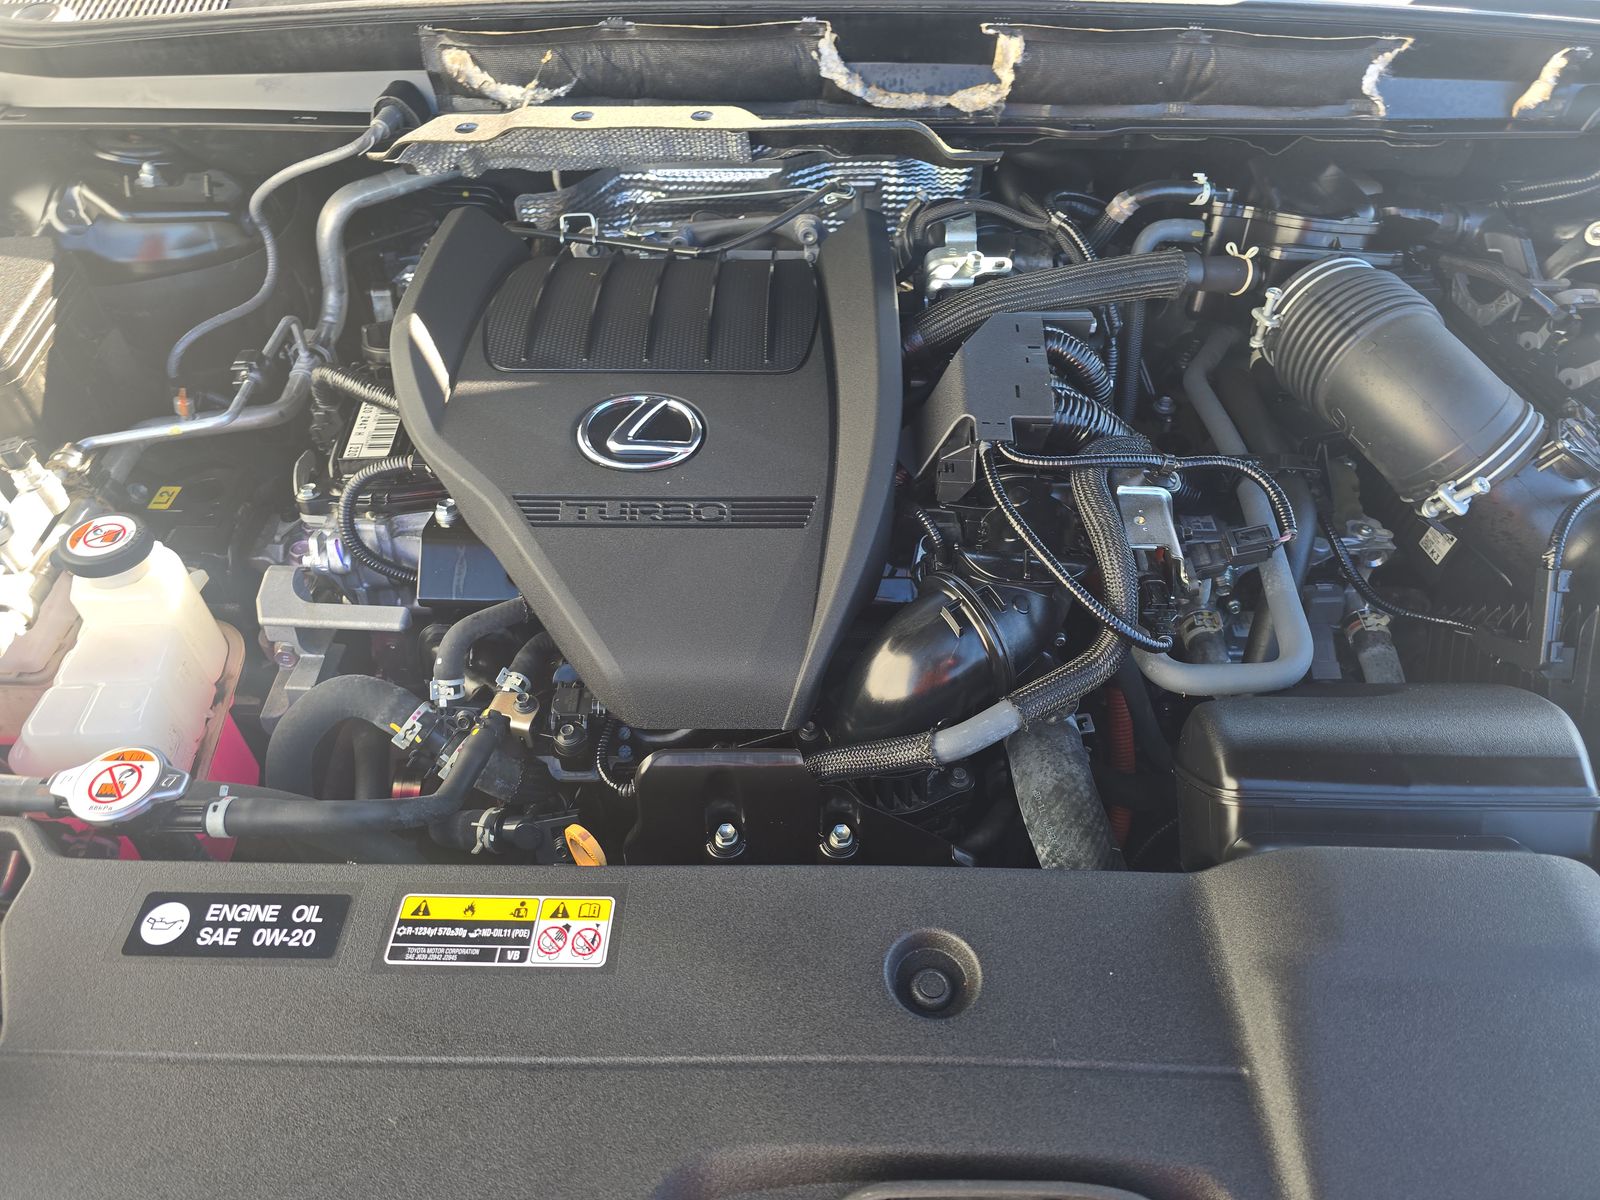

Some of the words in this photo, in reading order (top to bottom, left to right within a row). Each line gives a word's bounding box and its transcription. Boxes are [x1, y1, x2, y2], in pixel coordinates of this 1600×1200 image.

[152, 490, 176, 505] L2
[564, 501, 730, 522] TURBO
[205, 904, 282, 922] ENGINE
[291, 904, 324, 923] OIL
[196, 927, 242, 946] SAE
[252, 928, 316, 947] 0W-20
[511, 929, 530, 939] (POE)
